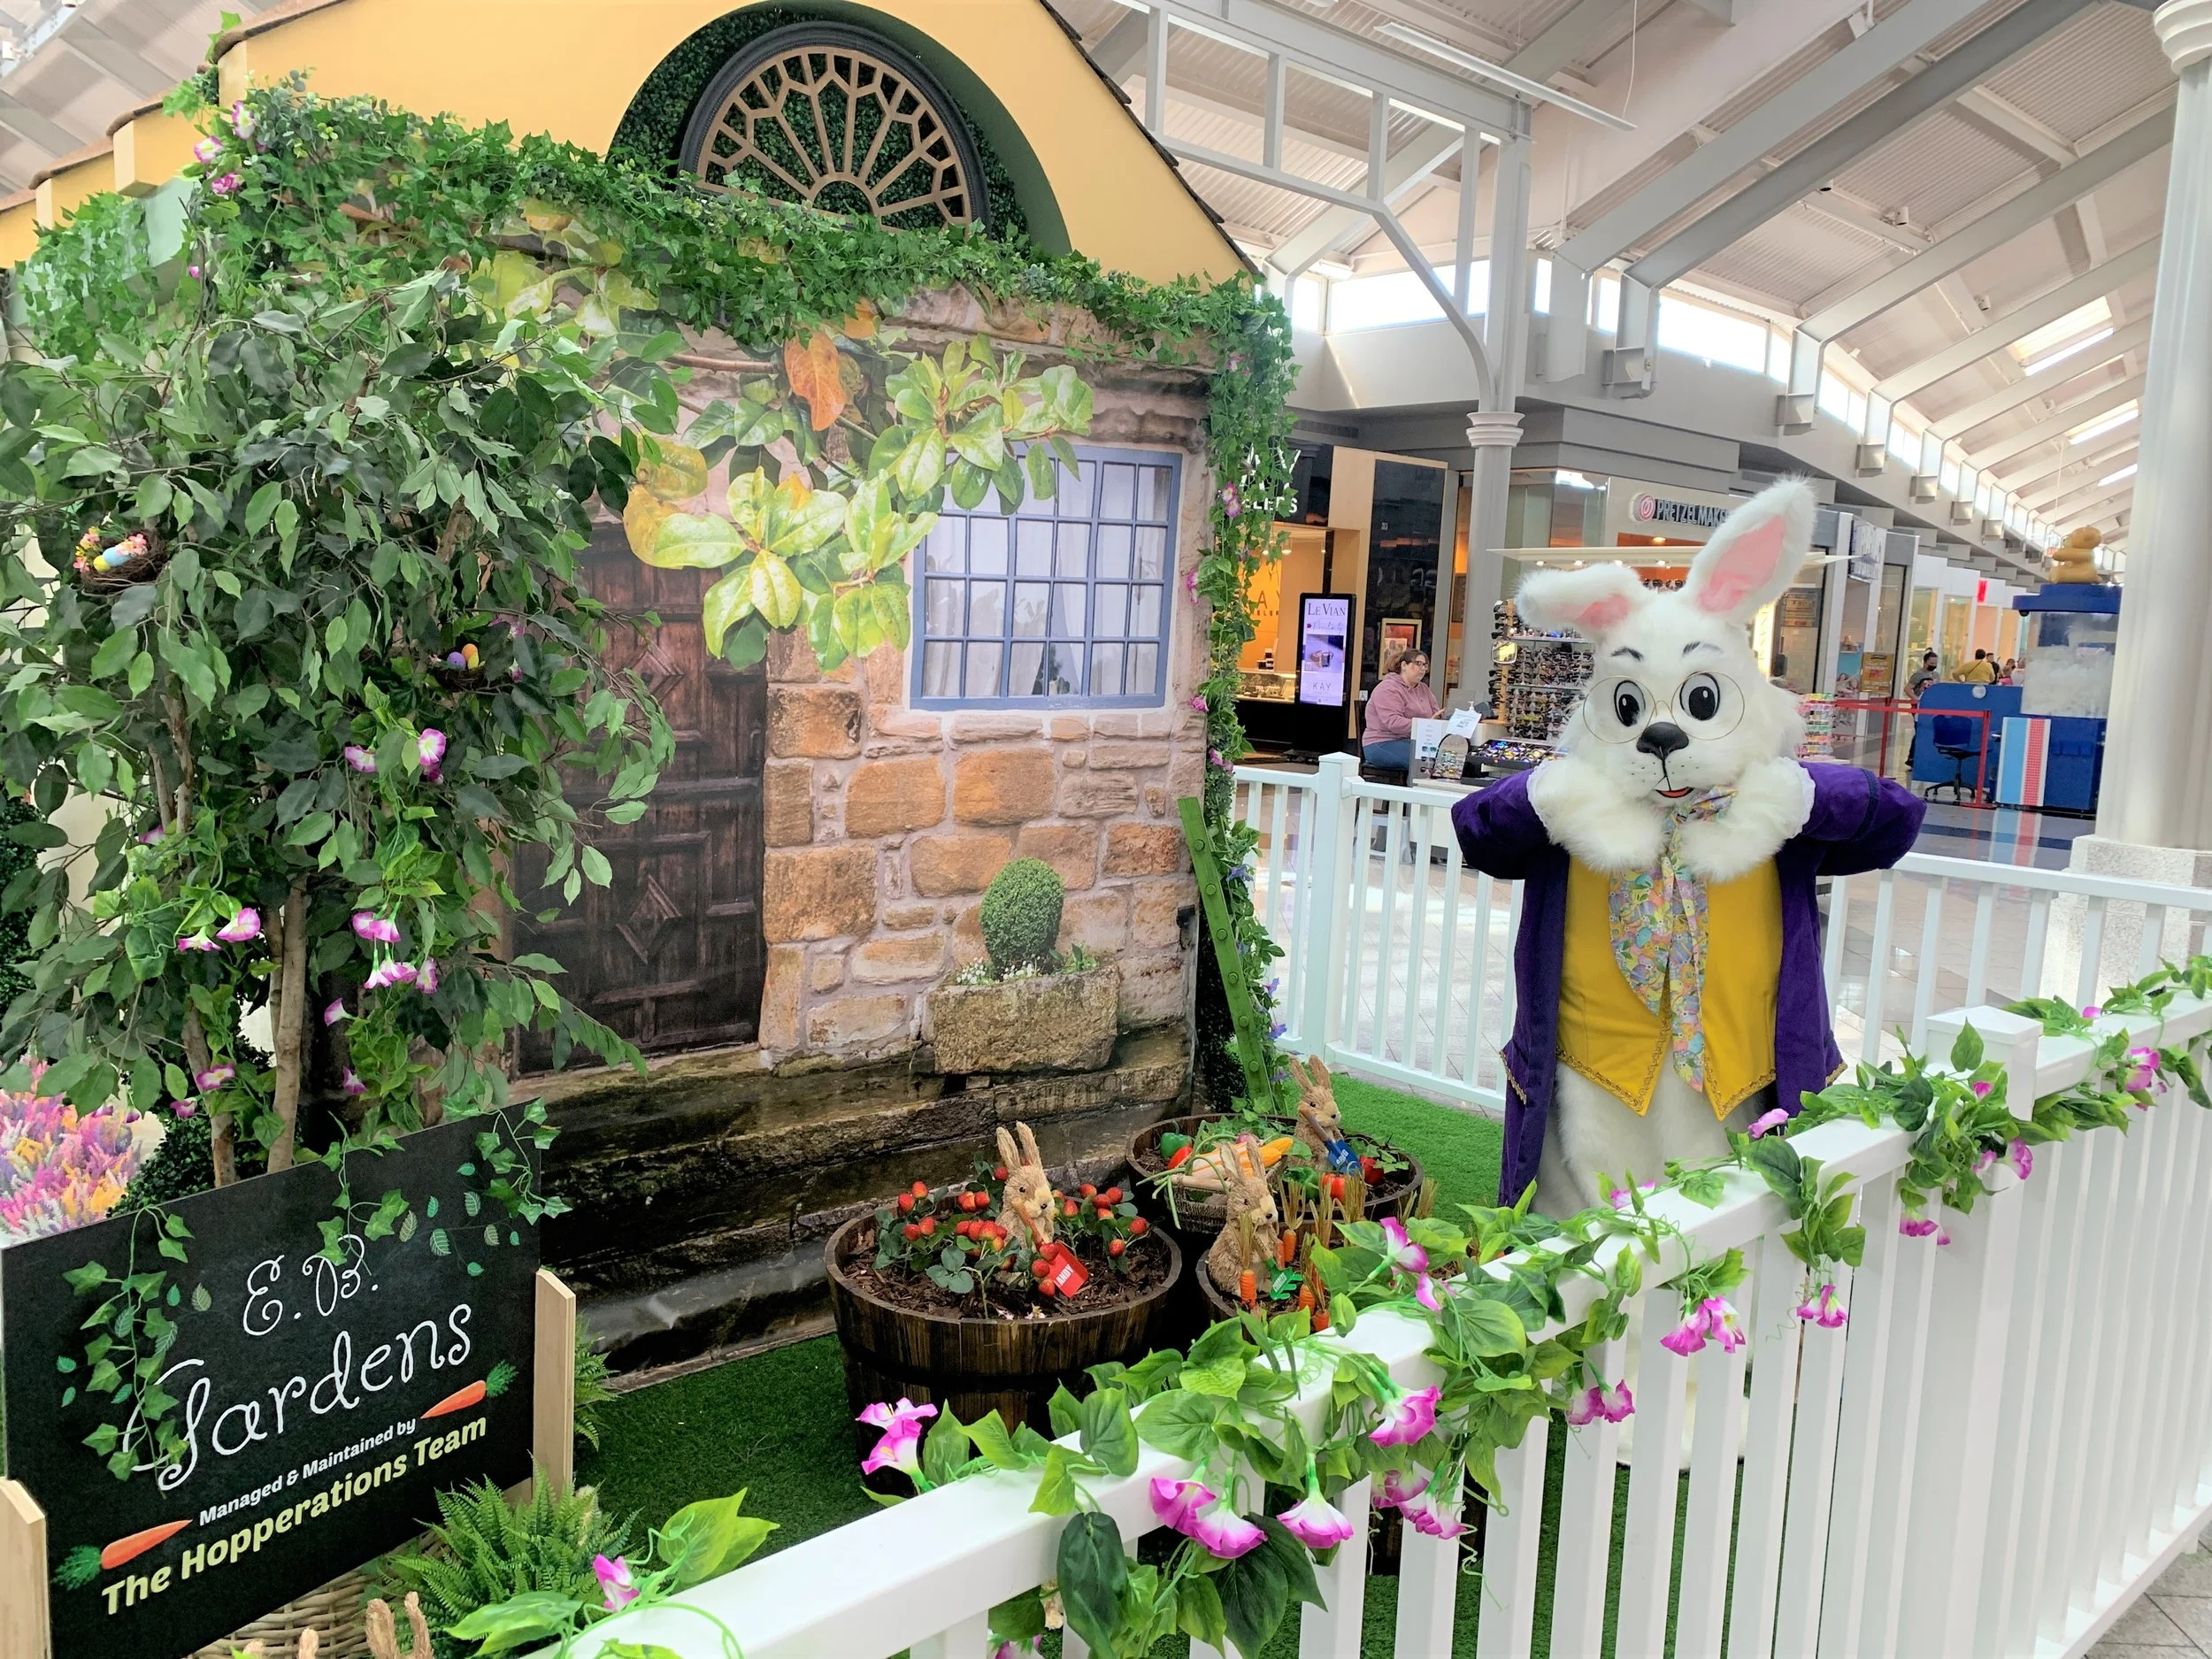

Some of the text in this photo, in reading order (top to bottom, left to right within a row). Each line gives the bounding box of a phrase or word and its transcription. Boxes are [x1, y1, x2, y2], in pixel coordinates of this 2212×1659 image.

[1656, 498, 1730, 527] PRETZELMAKE
[1312, 681, 1332, 691] KAY
[123, 1303, 472, 1492] Gardens
[102, 1417, 488, 1616] The Hopperations Team
[199, 1417, 417, 1526] Managed & Maintained by
